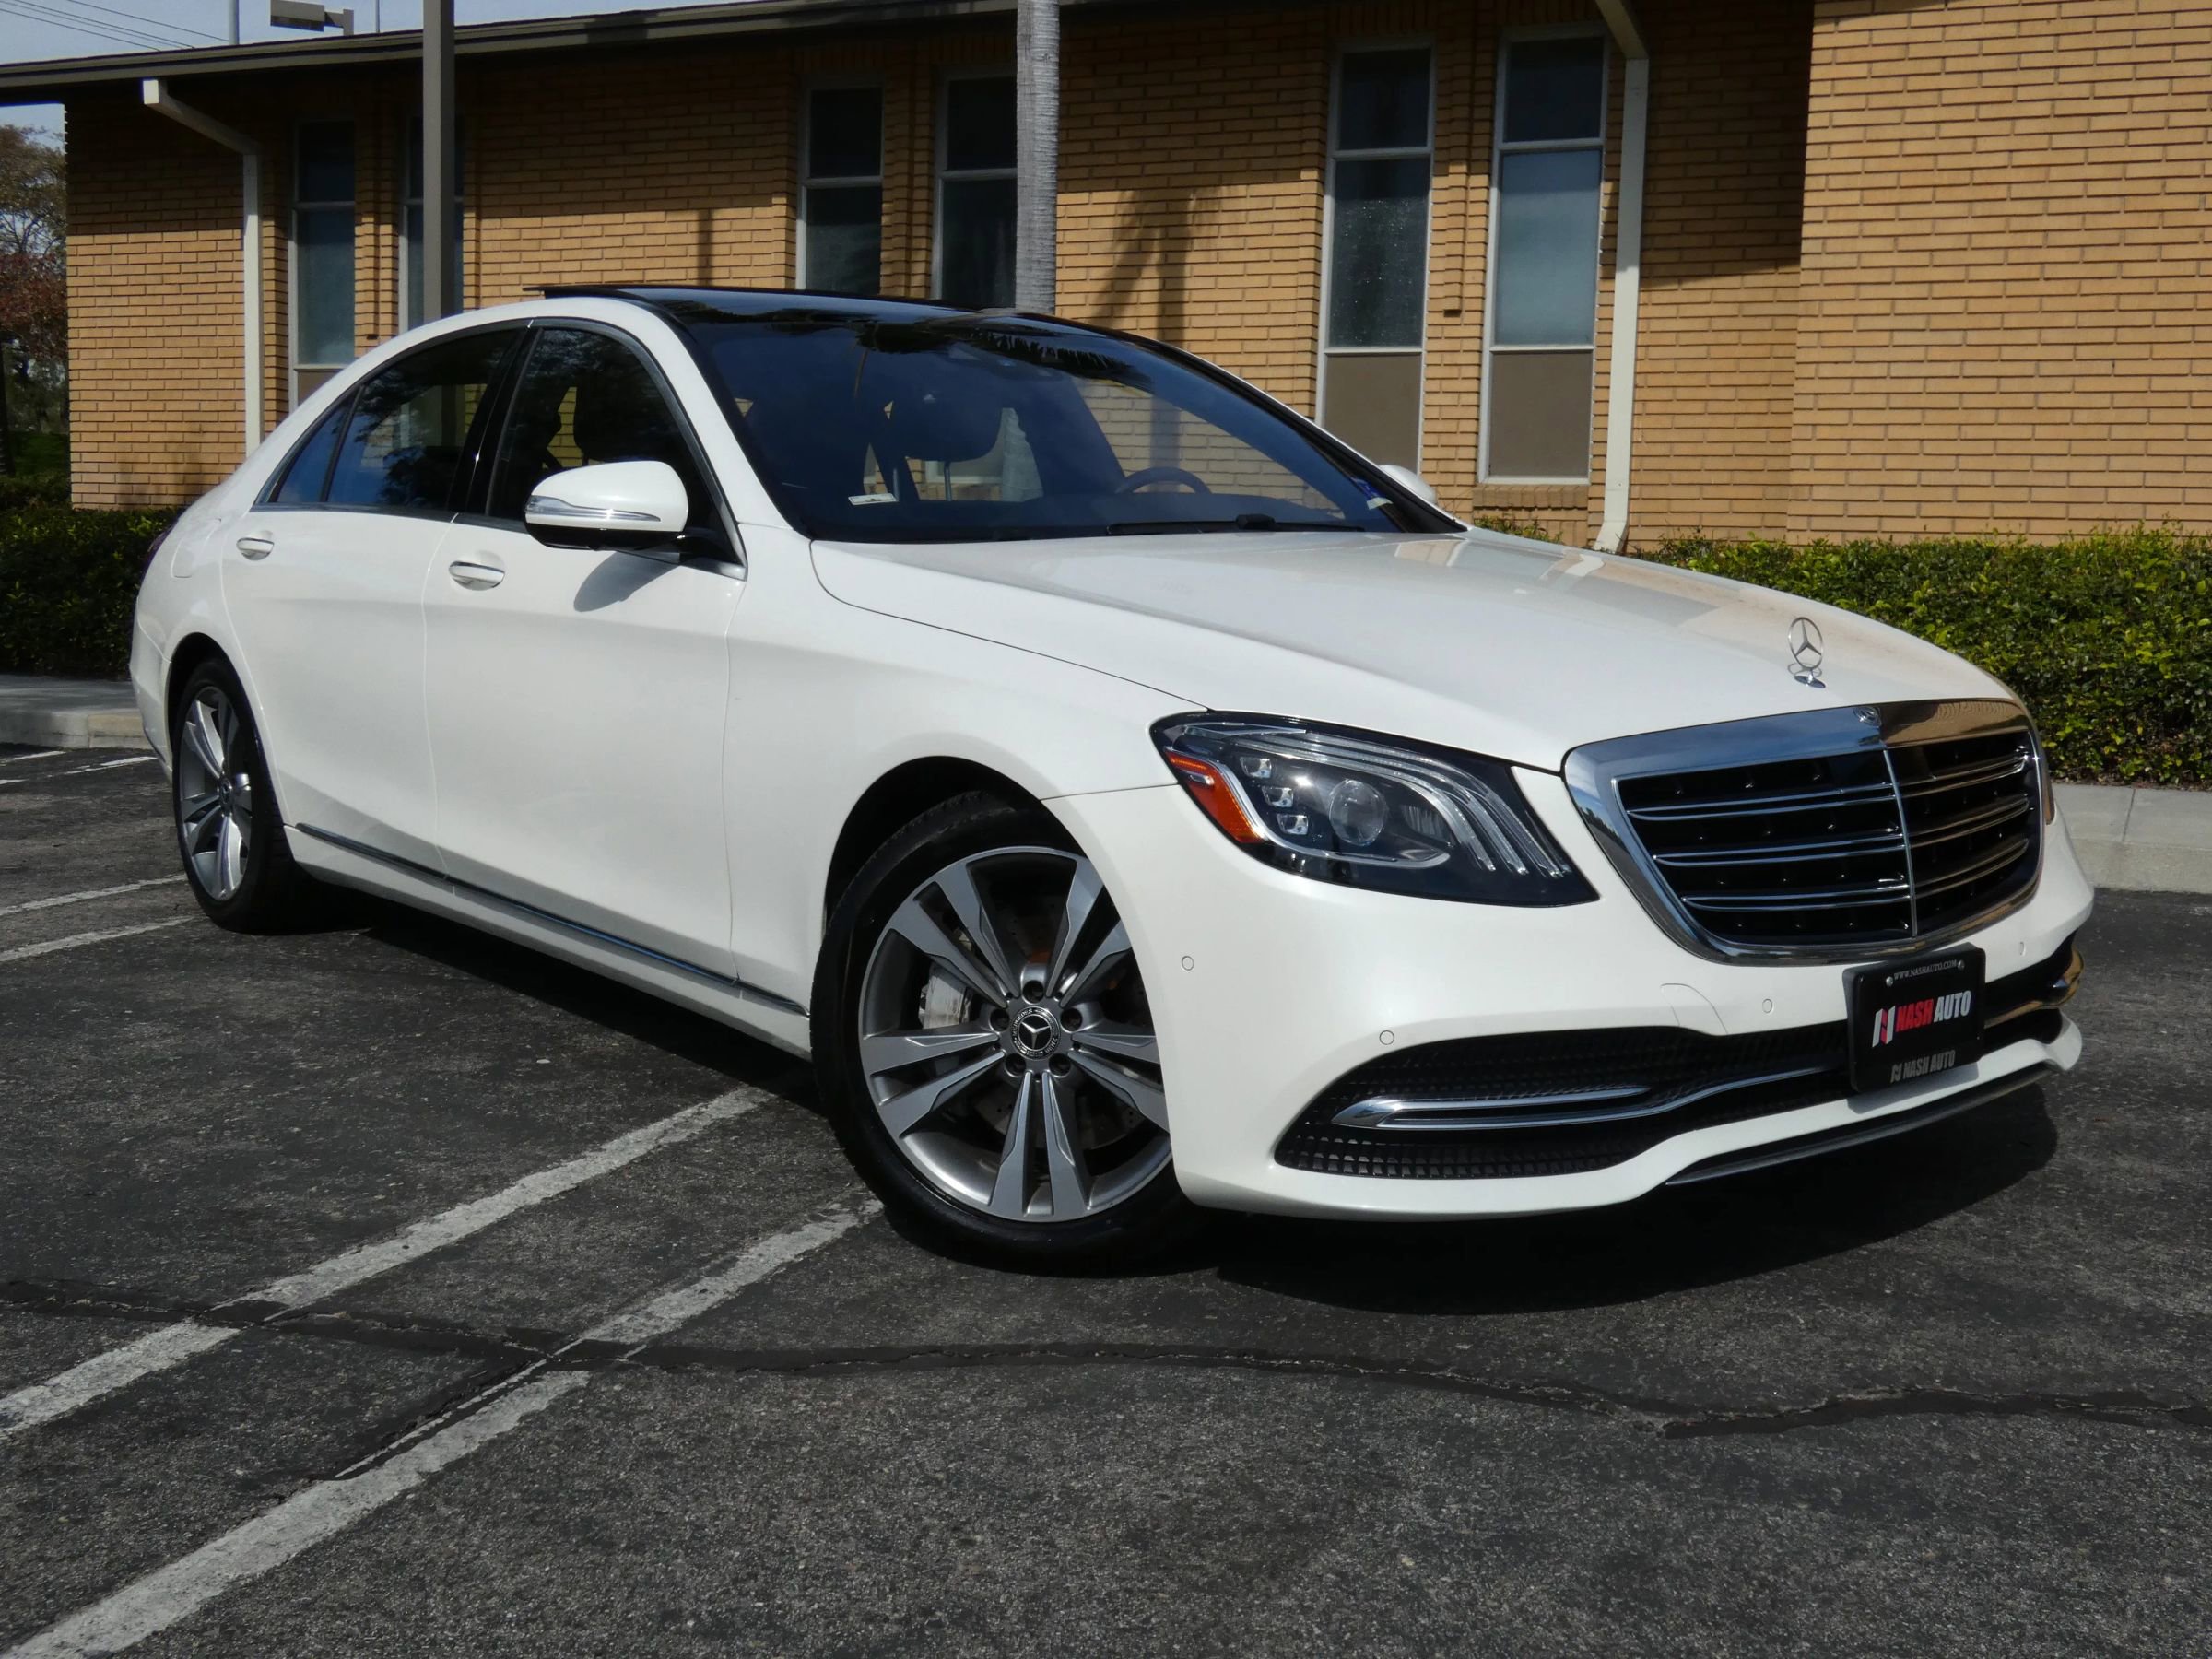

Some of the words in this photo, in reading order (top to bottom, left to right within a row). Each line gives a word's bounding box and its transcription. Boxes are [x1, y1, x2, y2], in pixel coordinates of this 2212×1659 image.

[1893, 959, 1958, 980] WWW.NASHAUTO.COM
[1895, 998, 1934, 1032] NASH
[1934, 990, 1972, 1023] AUTO
[1903, 1055, 1930, 1079] NASH
[1930, 1049, 1956, 1072] AUTO
